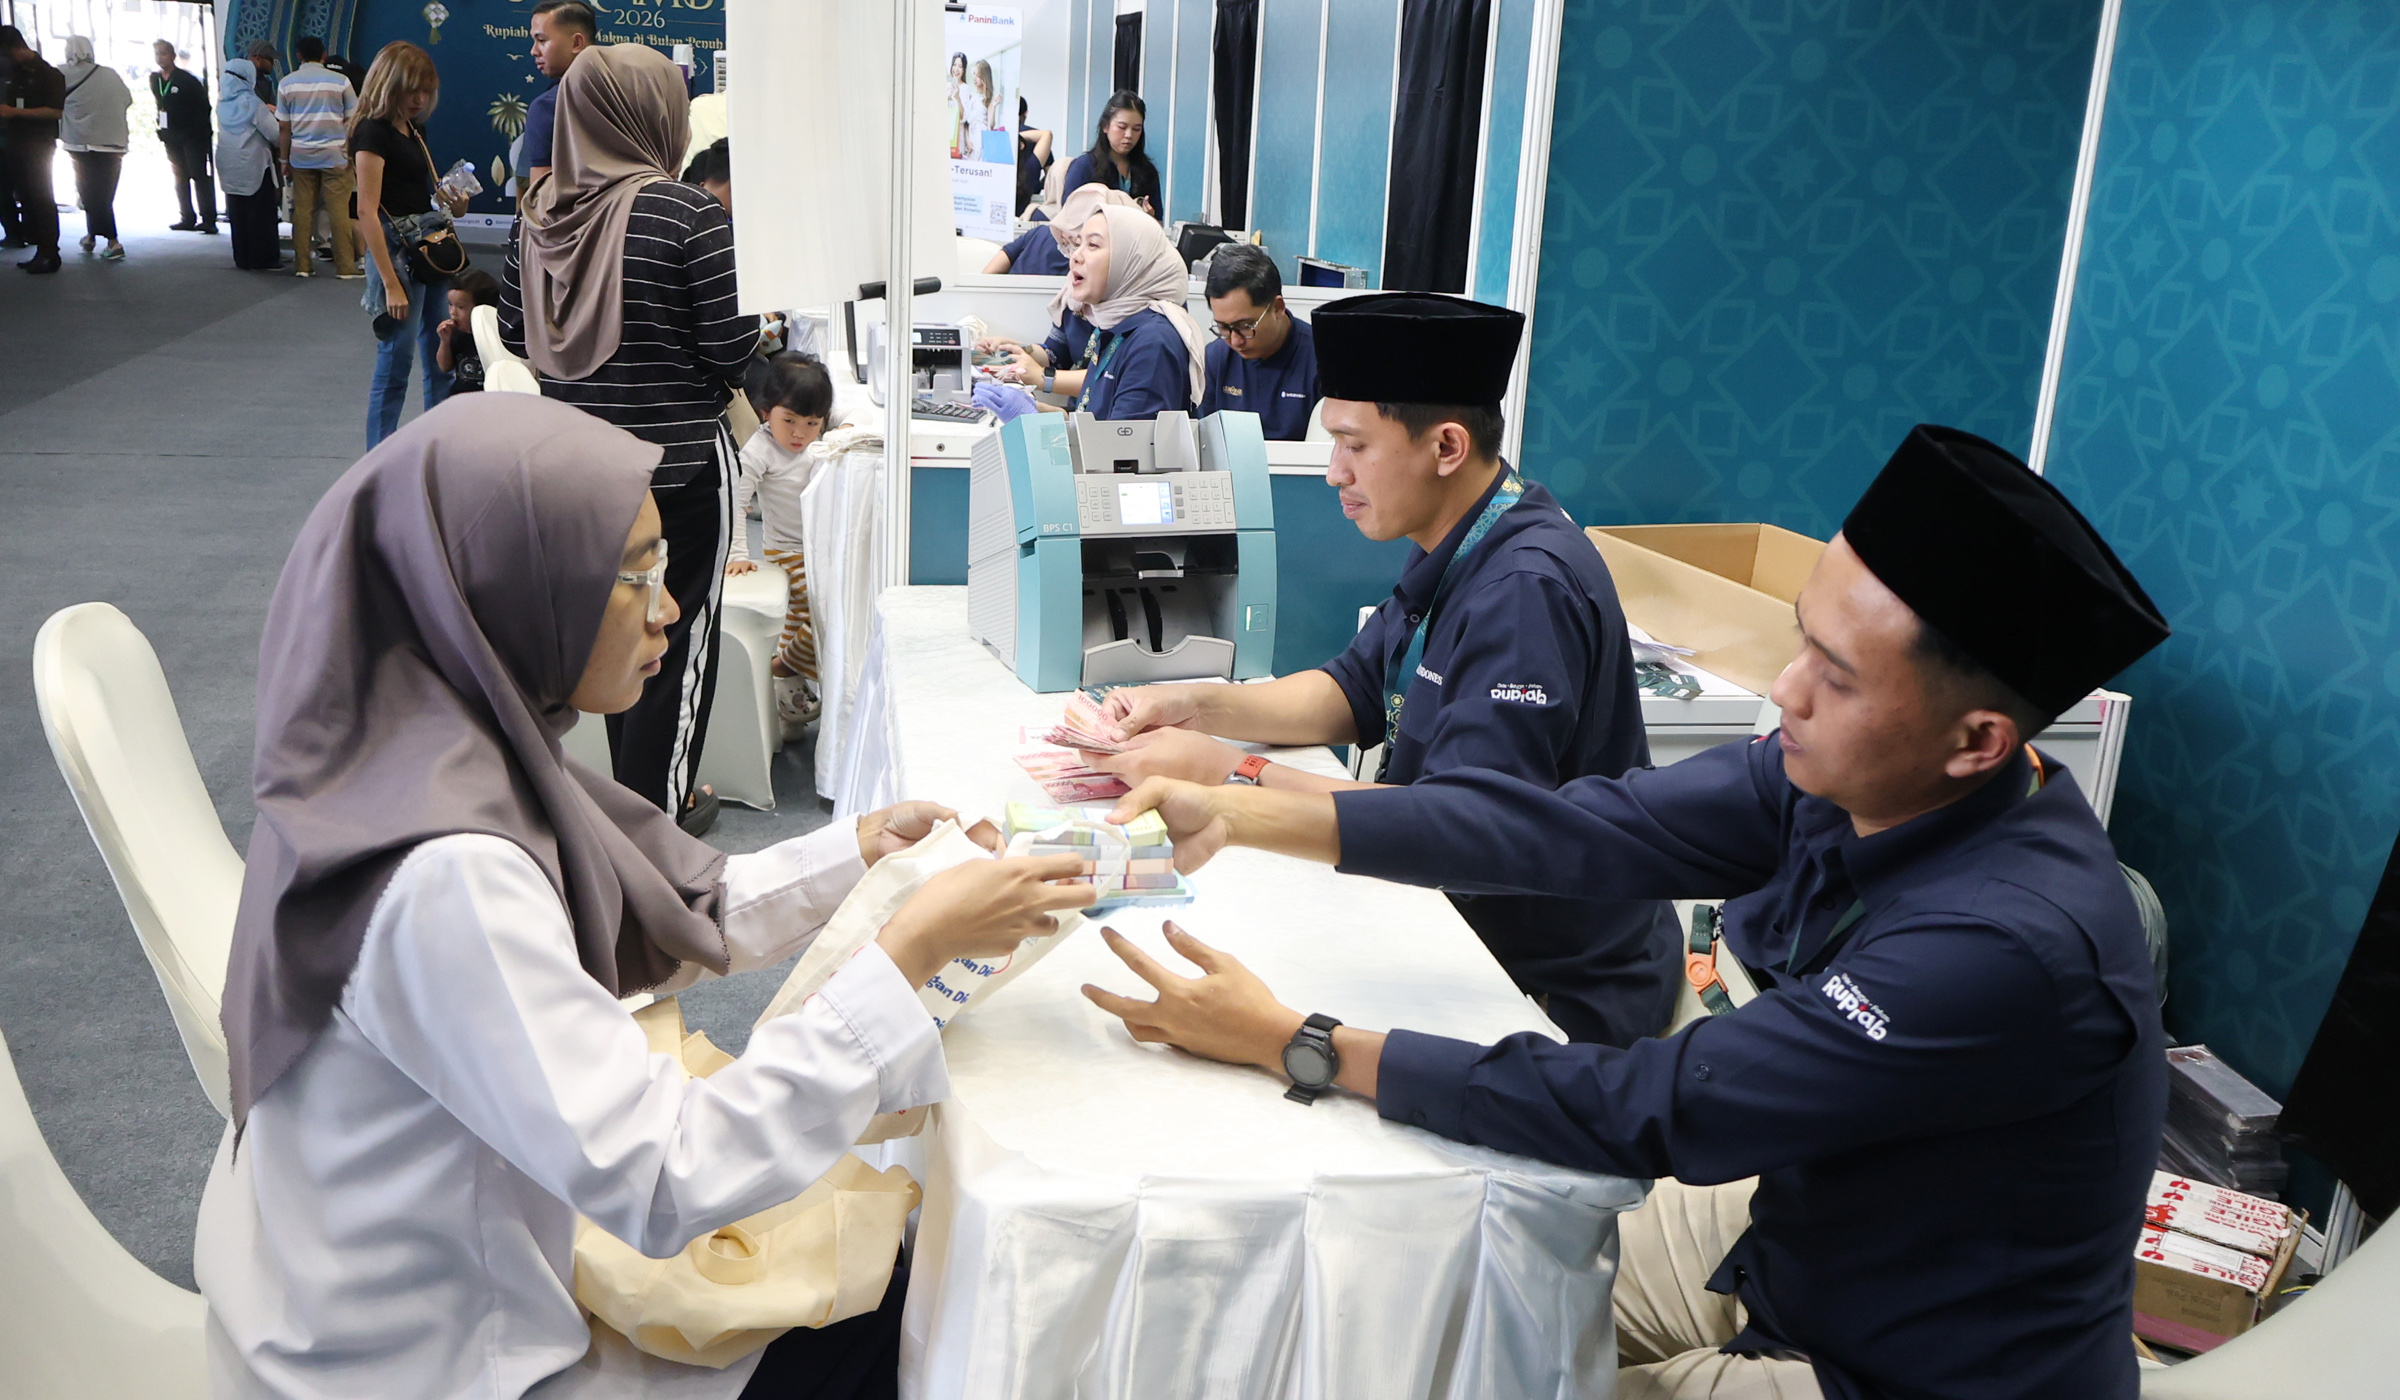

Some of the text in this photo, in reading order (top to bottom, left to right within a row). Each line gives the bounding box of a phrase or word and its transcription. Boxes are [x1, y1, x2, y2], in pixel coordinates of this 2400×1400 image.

[614, 9, 666, 28] 2026
[968, 14, 1015, 26] PaninBank
[483, 24, 529, 39] Rupiah
[633, 33, 644, 45] di
[647, 34, 683, 45] Bulan
[1043, 522, 1073, 532] BPS C1
